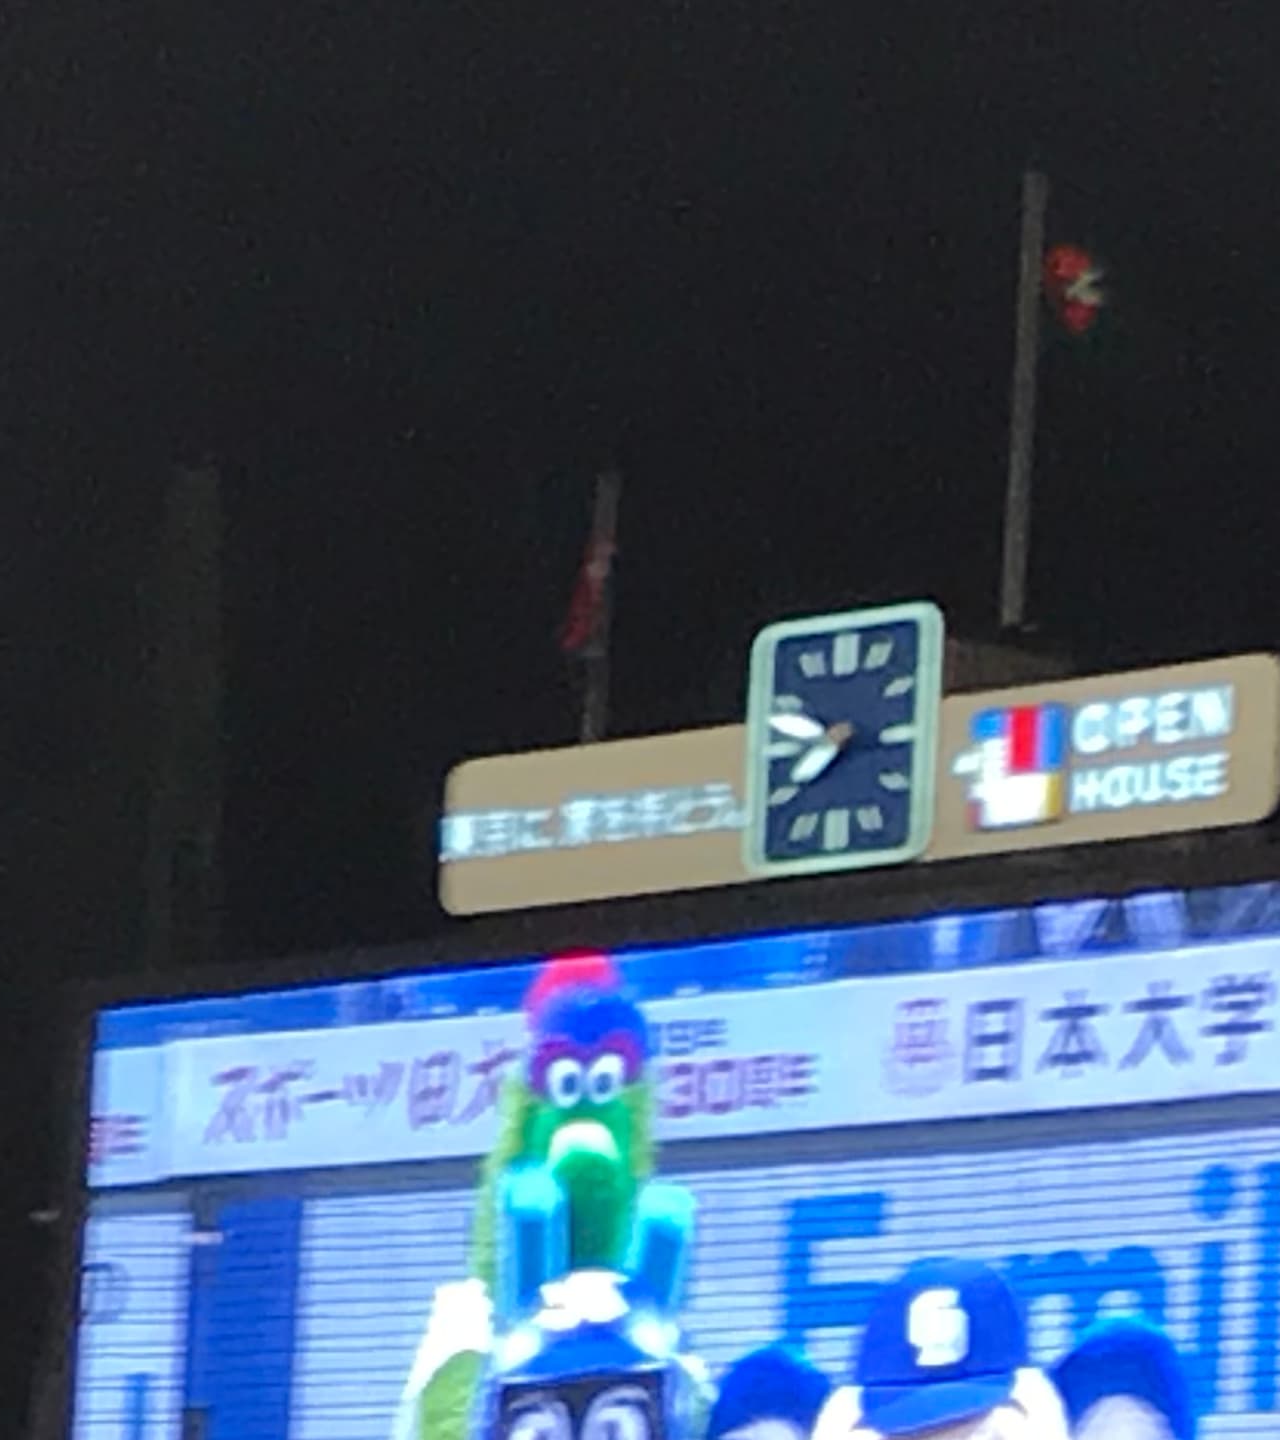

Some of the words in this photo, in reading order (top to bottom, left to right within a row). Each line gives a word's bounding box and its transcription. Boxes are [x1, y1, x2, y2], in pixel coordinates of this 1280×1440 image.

[1069, 752, 1230, 814] HOUSE
[962, 970, 1277, 1085] 日本大学
